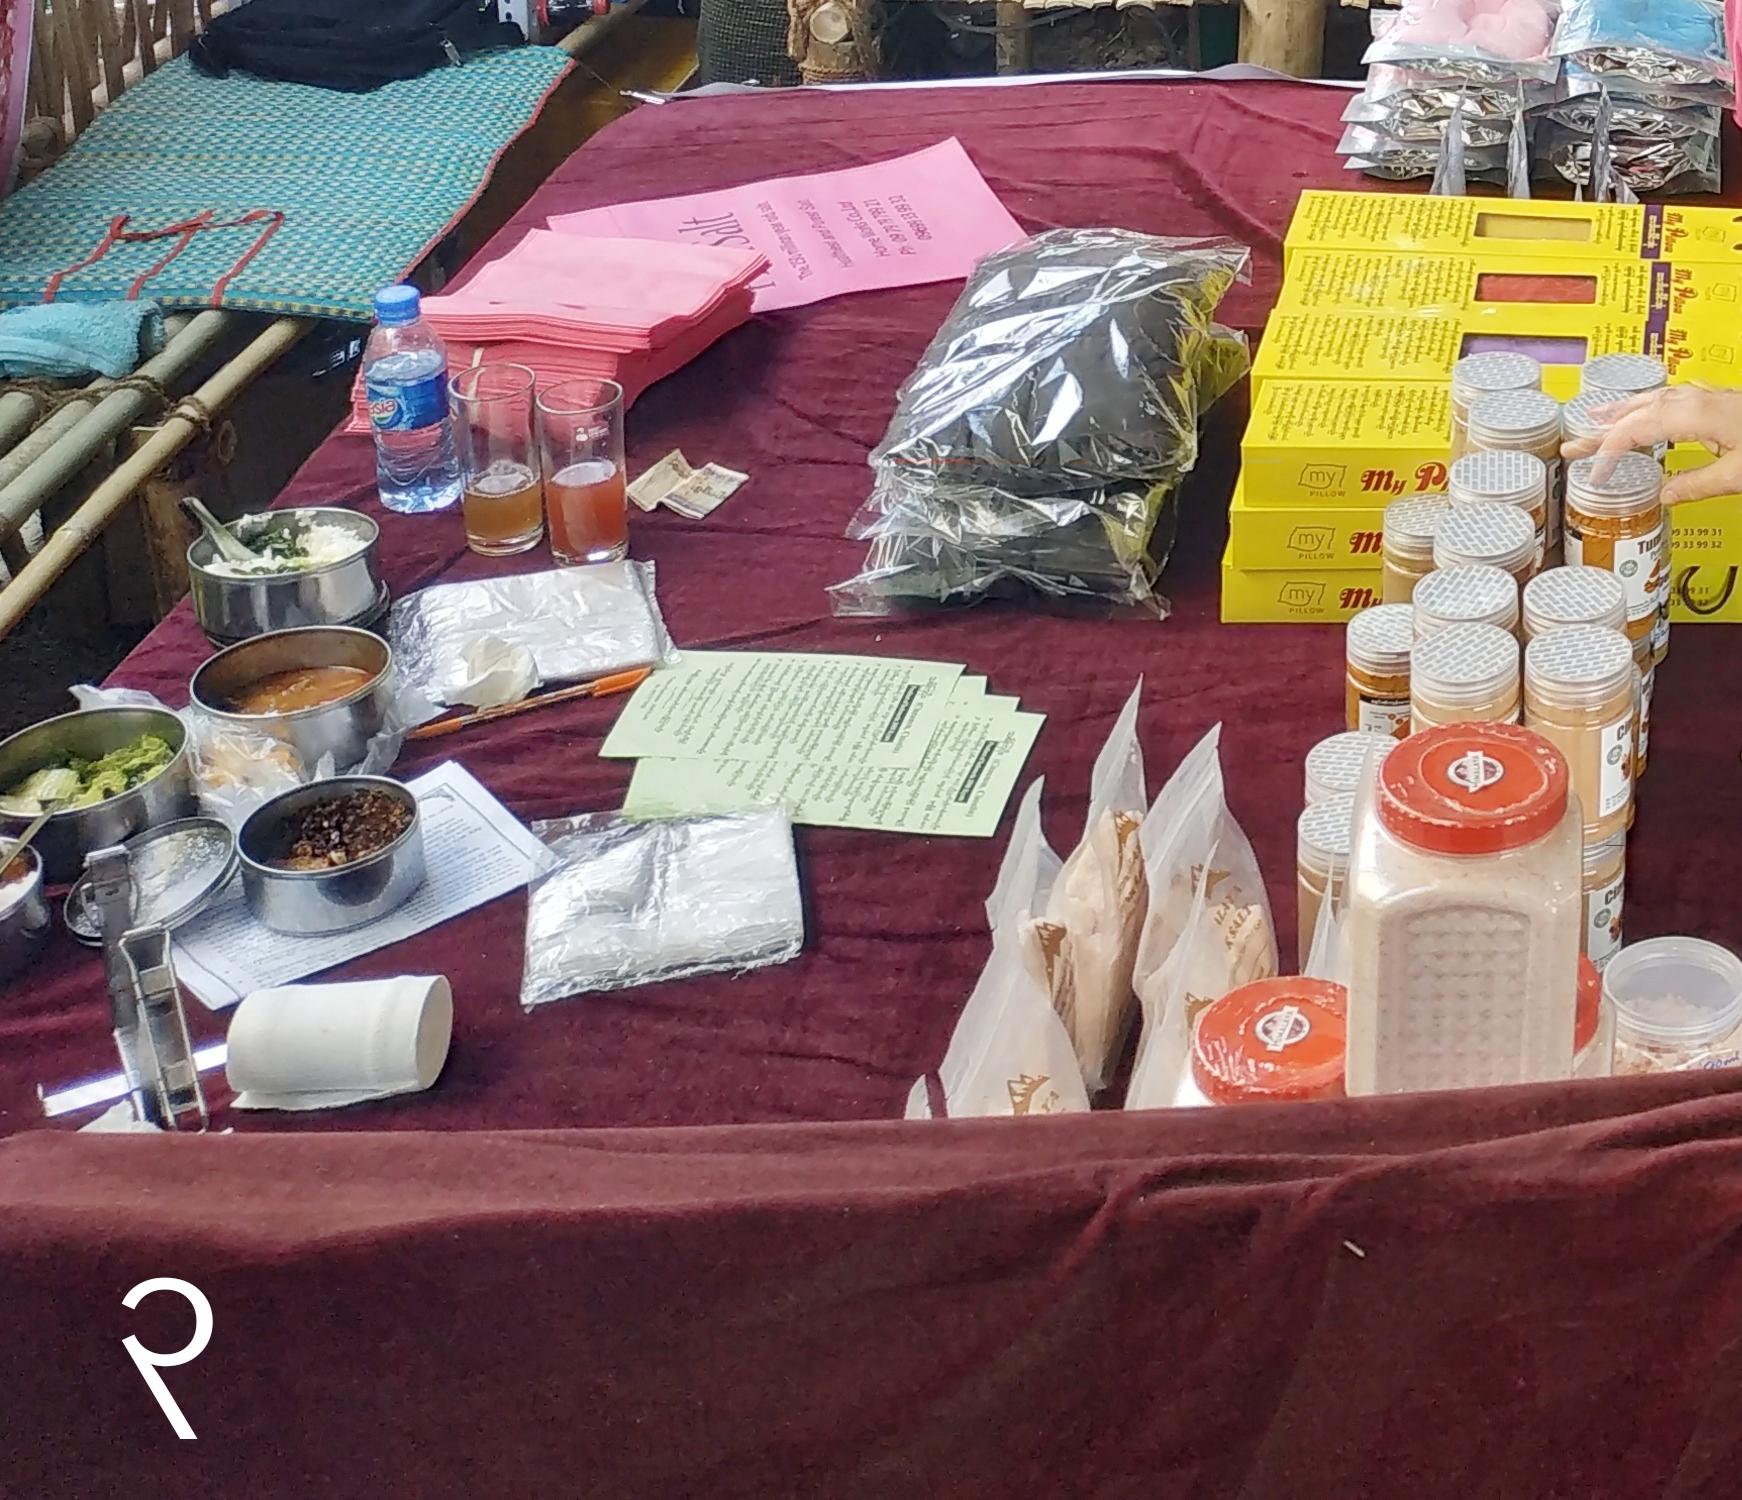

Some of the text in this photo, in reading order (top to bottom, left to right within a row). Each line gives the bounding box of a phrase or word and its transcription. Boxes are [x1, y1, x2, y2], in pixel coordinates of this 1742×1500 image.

[757, 201, 770, 212] salt
[773, 222, 788, 239] year
[779, 236, 798, 256] million
[868, 236, 891, 257] Home
[799, 264, 814, 280] The
[1309, 471, 1336, 486] my
[1361, 469, 1407, 496] My
[1683, 528, 1694, 536] 33
[1697, 528, 1709, 536] 99
[1711, 528, 1723, 536] 31
[1298, 534, 1325, 548] my
[1683, 541, 1694, 549] 33
[1697, 541, 1709, 549] 99
[1711, 541, 1722, 549] 32
[1298, 552, 1335, 560] PILLOW
[1289, 588, 1315, 602] my
[1272, 1010, 1294, 1047] HIMALAYA
